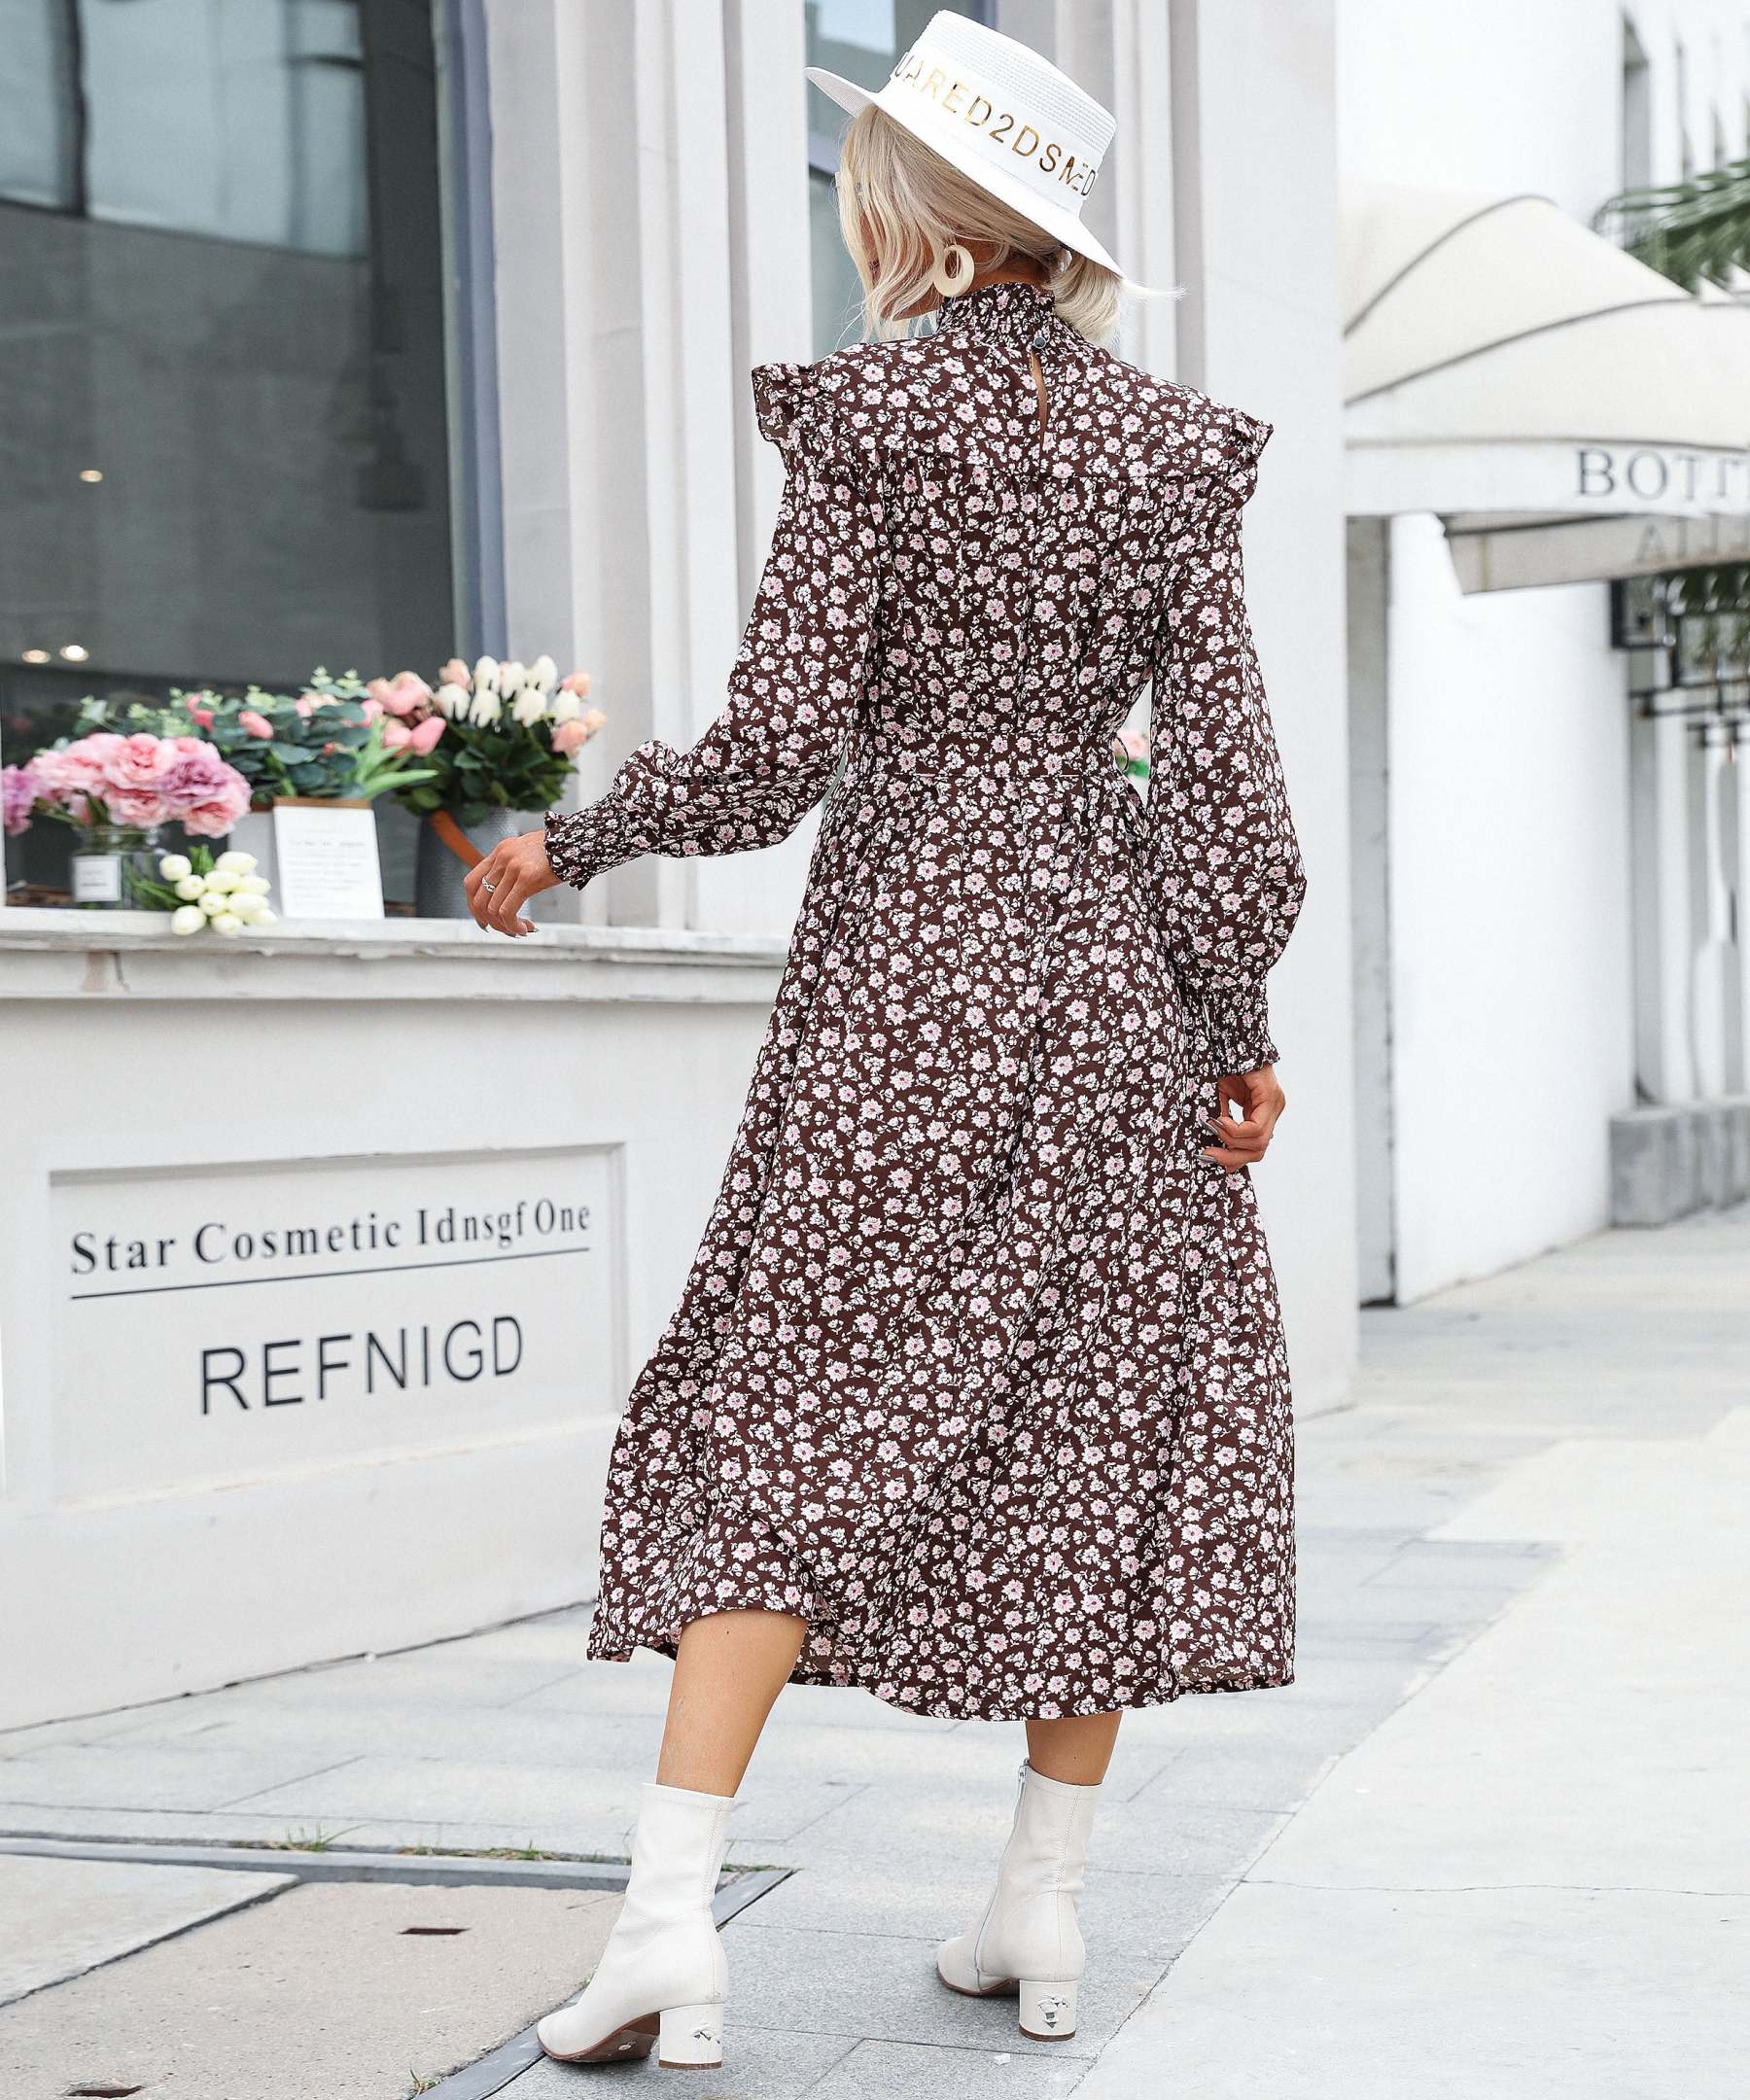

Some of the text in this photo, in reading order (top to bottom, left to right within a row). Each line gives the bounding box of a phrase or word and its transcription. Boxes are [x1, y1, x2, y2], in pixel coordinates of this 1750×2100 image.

[70, 1232, 177, 1276] Star
[192, 1212, 402, 1264] Cosmetic
[534, 1198, 591, 1235] One
[200, 1314, 523, 1416] REFNIGD
